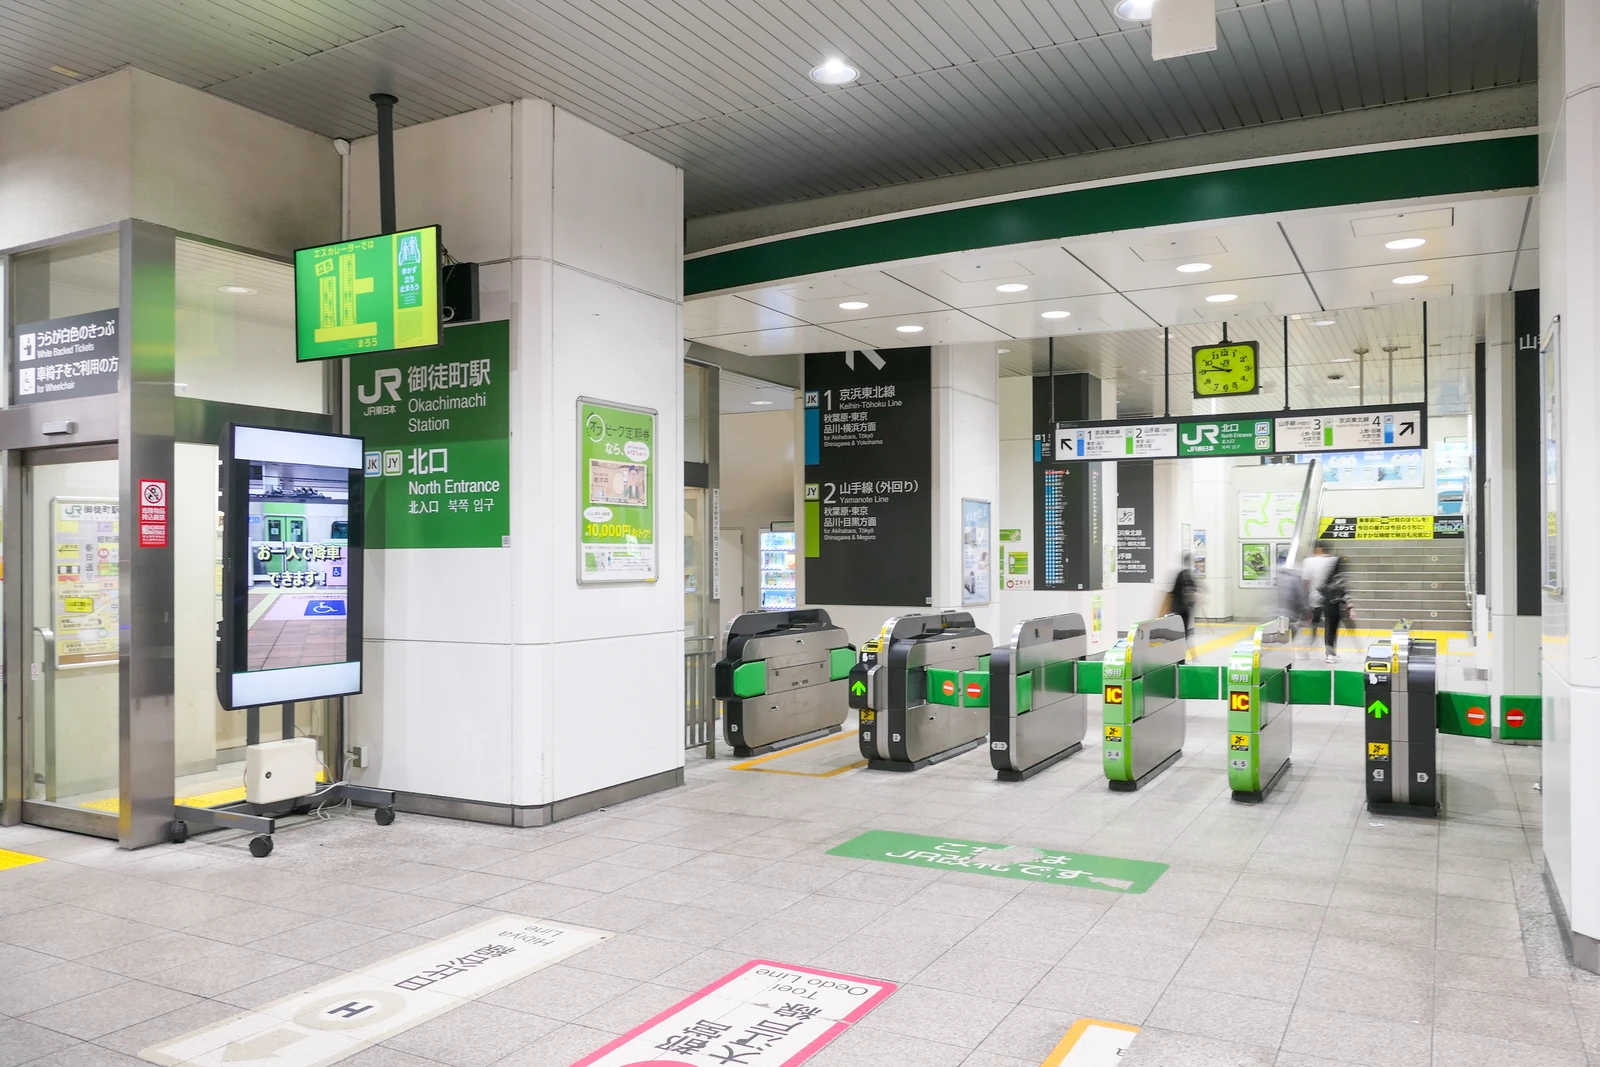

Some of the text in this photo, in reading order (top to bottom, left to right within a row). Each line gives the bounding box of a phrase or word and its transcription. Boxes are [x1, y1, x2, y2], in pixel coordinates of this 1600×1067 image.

[314, 240, 375, 258] エスカレーターでは
[37, 320, 115, 347] うらが白色のきっぷ
[357, 337, 378, 348] まろう
[1520, 333, 1540, 350] 山
[37, 343, 95, 358] White Backed Tickets
[37, 356, 119, 381] 車椅子をご利用の方
[407, 359, 491, 393] 御徒町駅
[44, 381, 76, 392] Wheelchair
[358, 367, 402, 405] JR
[839, 385, 896, 401] 京浜東北線
[408, 392, 487, 413] Okachimachi
[807, 395, 817, 404] JK
[824, 389, 832, 411] 1
[888, 399, 903, 407] Line
[363, 404, 396, 416] JR東日本
[408, 417, 450, 433] Station
[824, 412, 868, 424] 秋葉原・東京
[1314, 418, 1321, 430] 3
[1372, 416, 1380, 426] 4
[590, 421, 650, 441] オフピーク定期券
[824, 422, 876, 434] 品川・横浜方面
[1087, 430, 1092, 440] 1
[1136, 428, 1142, 438] 2
[1182, 424, 1219, 445] JR
[1221, 424, 1238, 432] 北口
[367, 458, 378, 470] JK
[387, 457, 399, 469] JY
[407, 448, 449, 476] 北口
[408, 478, 500, 495] North Entrance
[807, 487, 817, 497] JY
[824, 482, 837, 504] 2
[408, 500, 439, 515] 北入口
[447, 498, 495, 513] 북쪽 입구
[840, 496, 873, 504] Yamanote
[65, 505, 82, 514] JR
[824, 506, 868, 516] 秋葉原・東京
[824, 516, 876, 527] 品川・目黒方面
[258, 545, 341, 562] お一人で降車
[268, 571, 327, 588] できます！
[1106, 688, 1122, 703] IC
[1232, 694, 1250, 710] IC
[499, 931, 555, 946] Hibiya
[525, 926, 564, 937] Line
[393, 943, 517, 991] 日比谷線
[756, 968, 868, 996] Oedo Line
[771, 983, 818, 1000] Toei
[328, 1001, 373, 1019] H
[654, 1019, 733, 1055] 都営
[709, 1002, 822, 1064] 大江戸線
